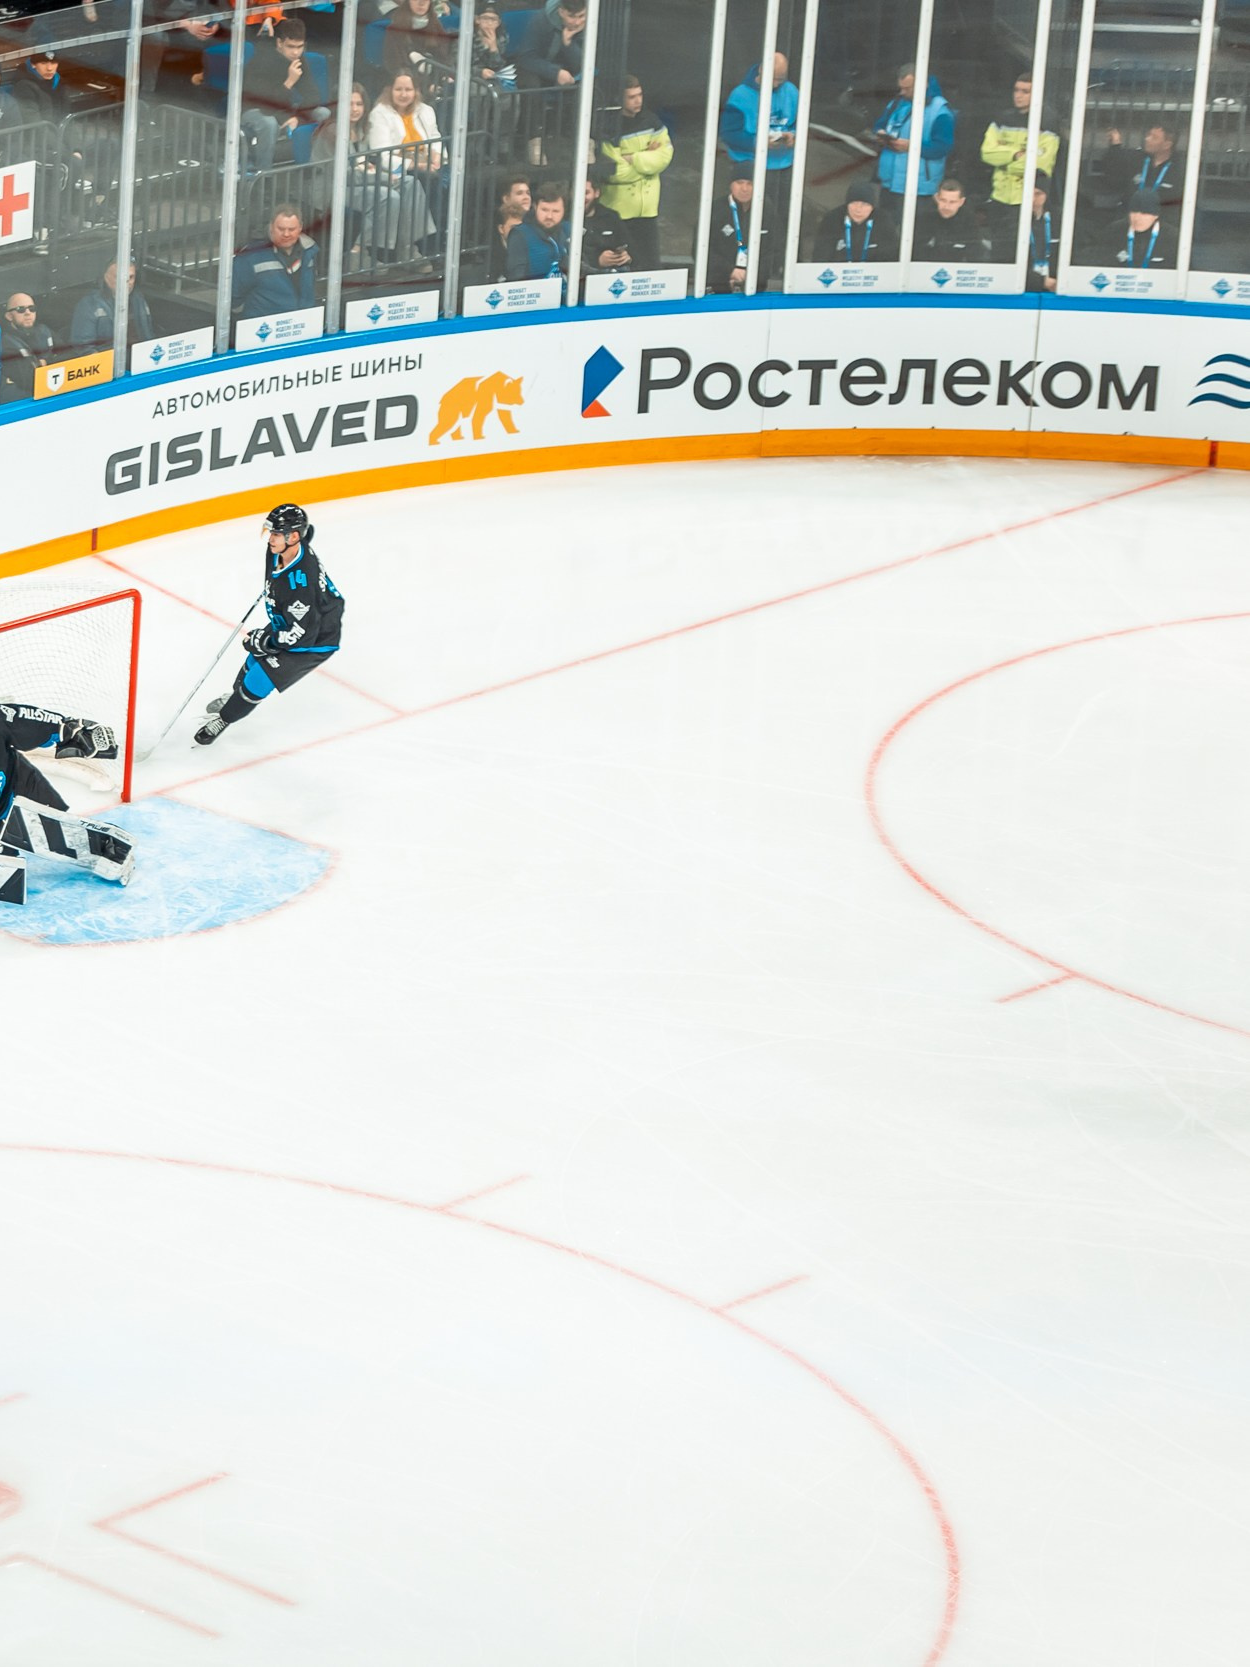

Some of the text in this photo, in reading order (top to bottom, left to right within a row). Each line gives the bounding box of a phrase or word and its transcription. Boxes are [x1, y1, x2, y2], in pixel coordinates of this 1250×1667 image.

[52, 364, 100, 384] Т БАНК
[152, 353, 422, 418] АВТОМОБИЛЬНЫЕ ШИНЫ
[637, 347, 1160, 414] Ростелеком
[104, 394, 419, 495] GISLAVED
[287, 569, 308, 590] 14
